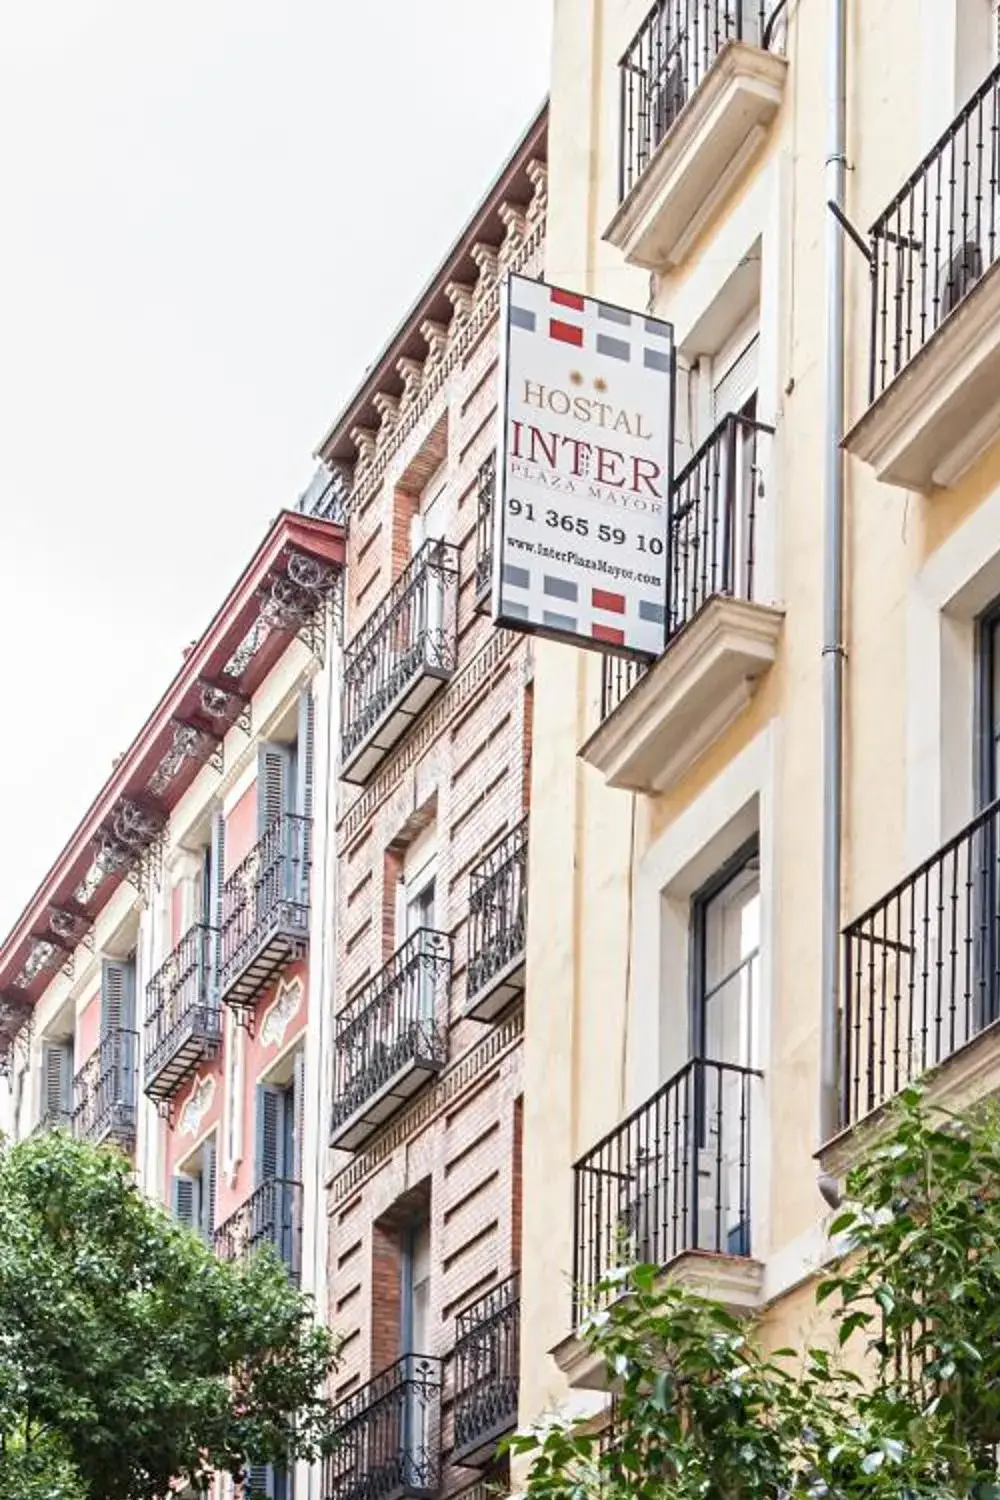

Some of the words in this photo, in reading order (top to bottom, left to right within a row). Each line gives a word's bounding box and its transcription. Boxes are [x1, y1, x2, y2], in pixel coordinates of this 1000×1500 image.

[523, 378, 653, 440] HOSTAL
[511, 419, 663, 498] INTER
[511, 463, 577, 492] PLAZA
[589, 486, 663, 514] MAYOR
[508, 497, 536, 522] 91
[545, 508, 589, 537] 365
[597, 523, 626, 546] 59
[636, 533, 664, 556] 10
